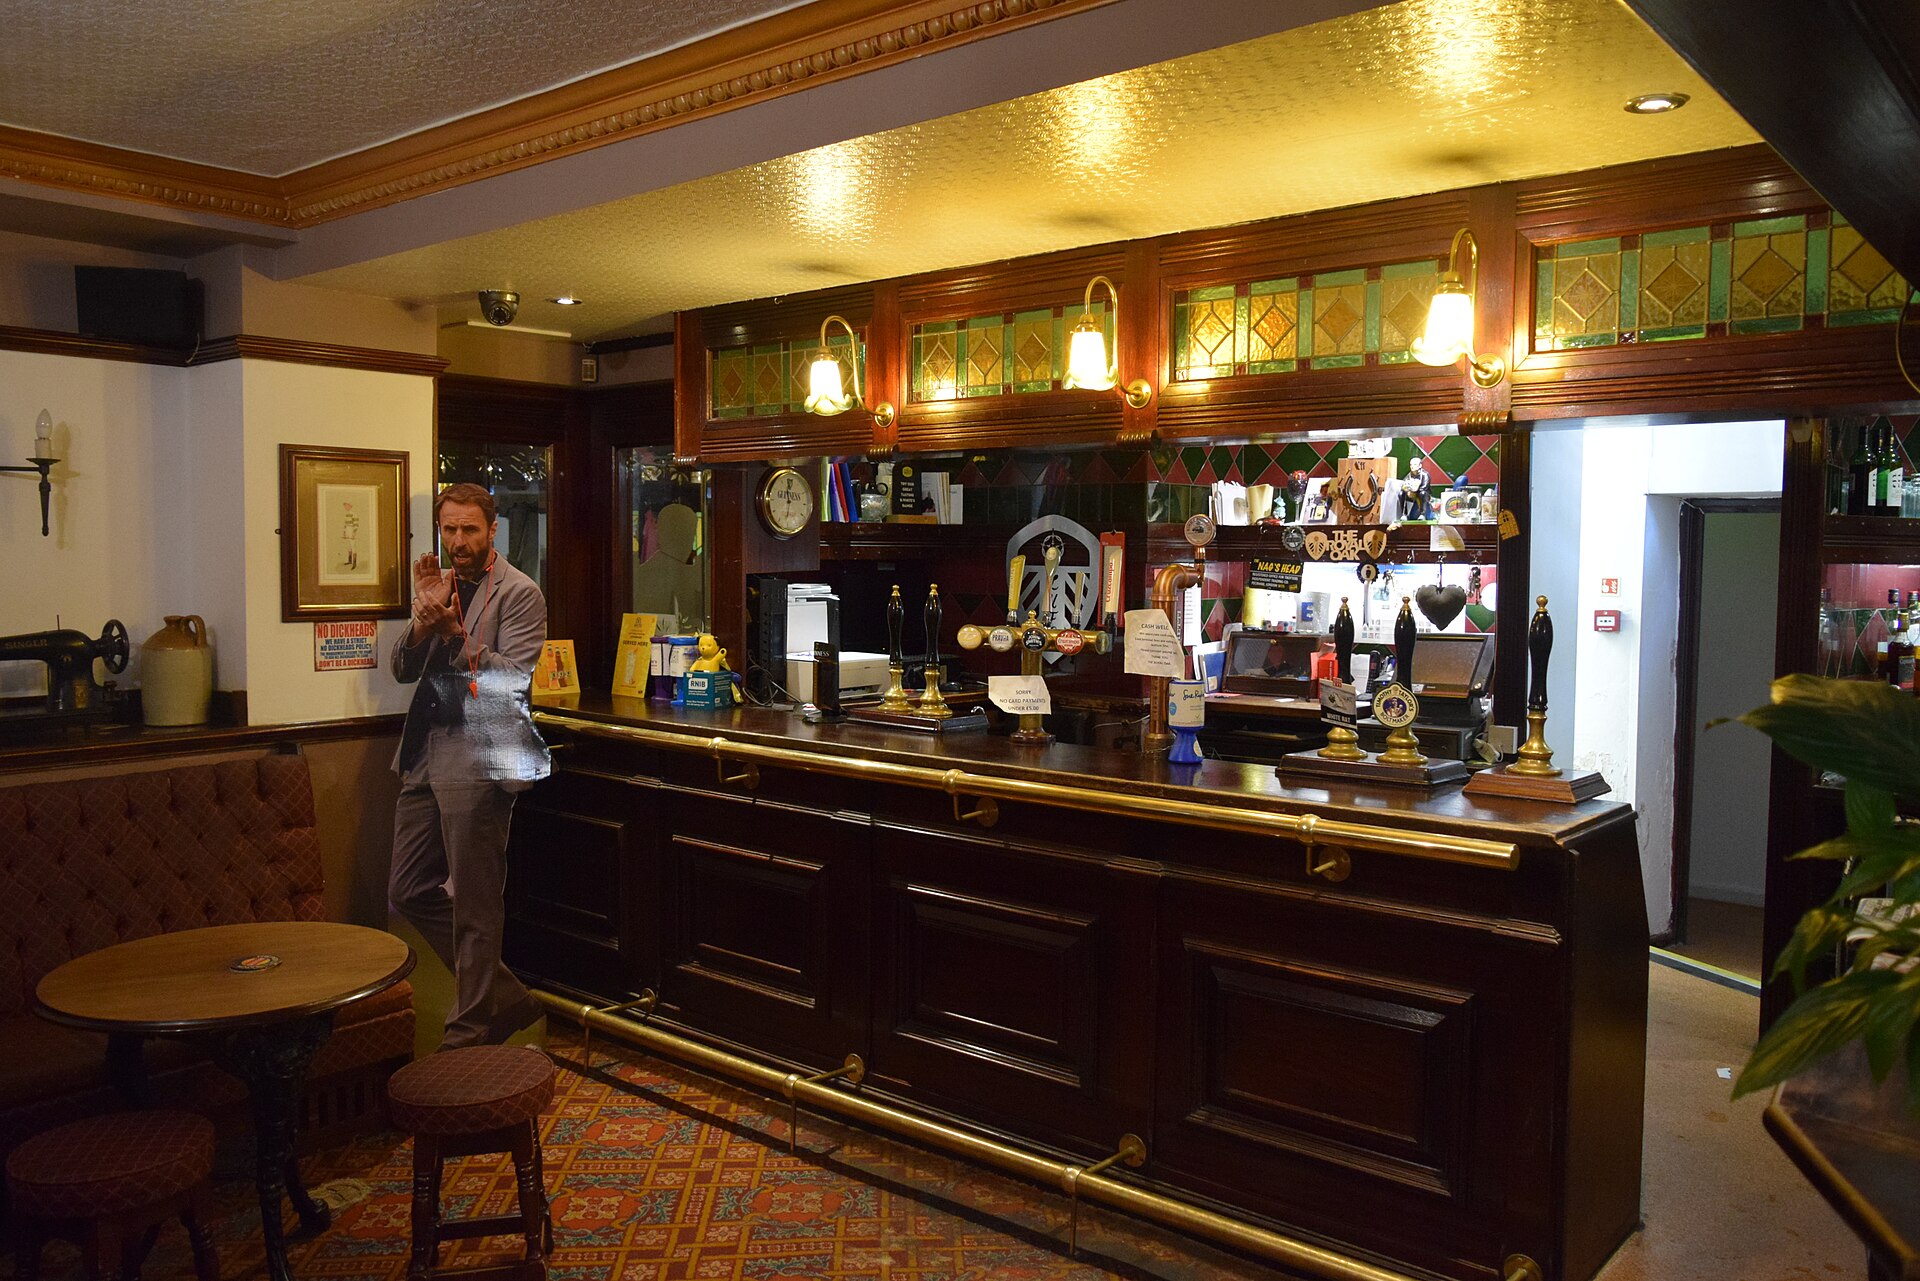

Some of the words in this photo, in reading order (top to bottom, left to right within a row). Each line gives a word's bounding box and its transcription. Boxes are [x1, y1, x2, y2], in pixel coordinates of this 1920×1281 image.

[1332, 530, 1358, 540] THE
[1326, 540, 1368, 551] ROYAL
[1330, 550, 1360, 560] OAK
[1258, 562, 1280, 572] NAG'S
[1281, 564, 1301, 574] HEAD
[1302, 602, 1314, 622] E
[317, 623, 329, 638] NO
[330, 622, 375, 638] DICKHEADS
[4, 639, 48, 649] SINGER
[1376, 689, 1392, 708] TIMOTHY
[1398, 690, 1415, 712] TAYLOR'S
[1326, 712, 1340, 720] WHITE
[1380, 711, 1410, 723] BOLTMAKER
